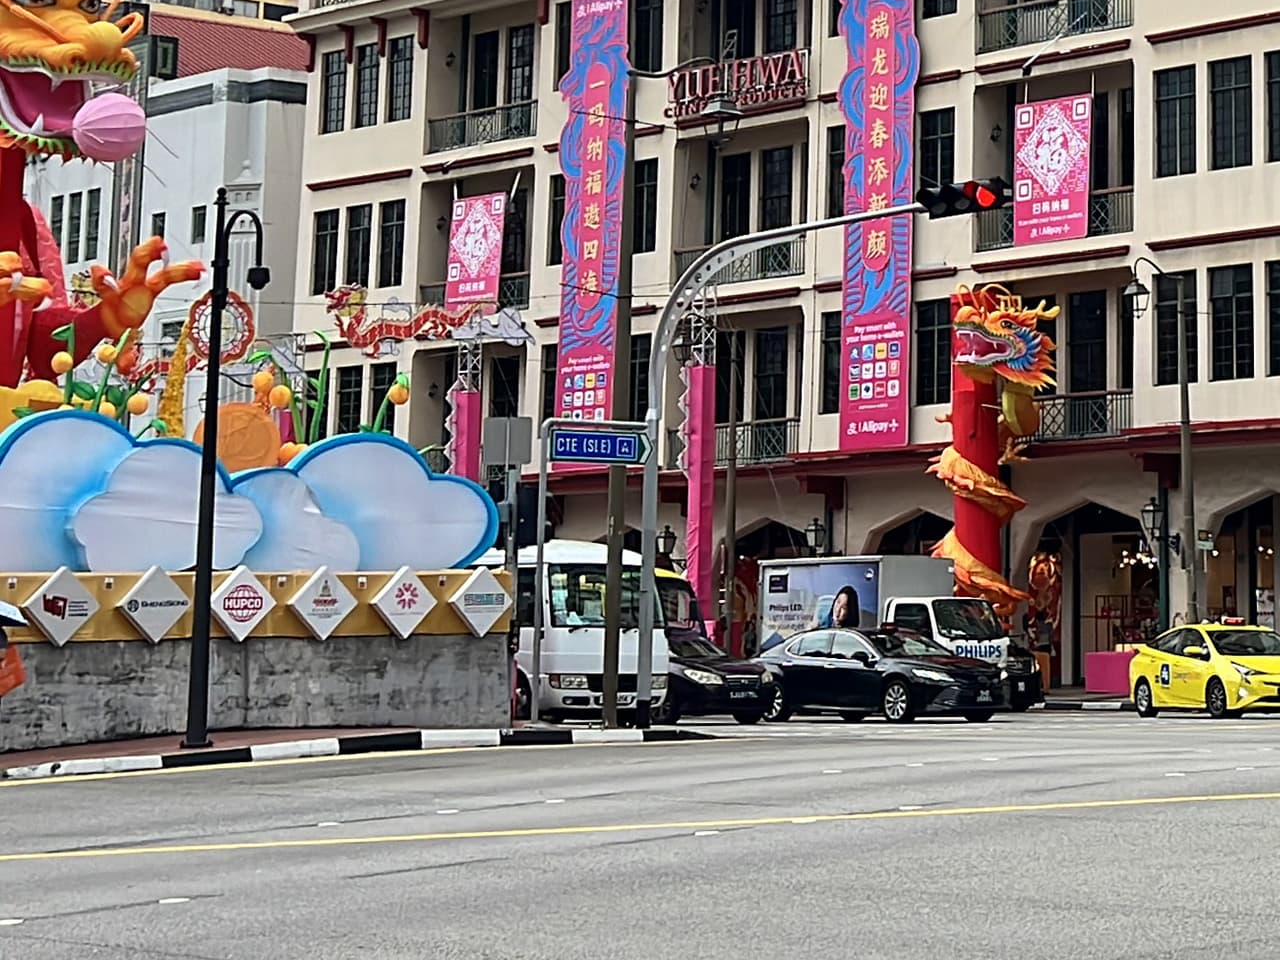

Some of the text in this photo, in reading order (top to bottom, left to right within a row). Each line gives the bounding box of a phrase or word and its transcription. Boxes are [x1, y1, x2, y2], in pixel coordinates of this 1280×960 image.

[668, 49, 804, 102] YUE HWA
[557, 438, 611, 454] CTE (SLE)
[224, 598, 261, 609] HUPCO
[769, 604, 789, 612] Philips
[955, 645, 1002, 657] PHILIPS
